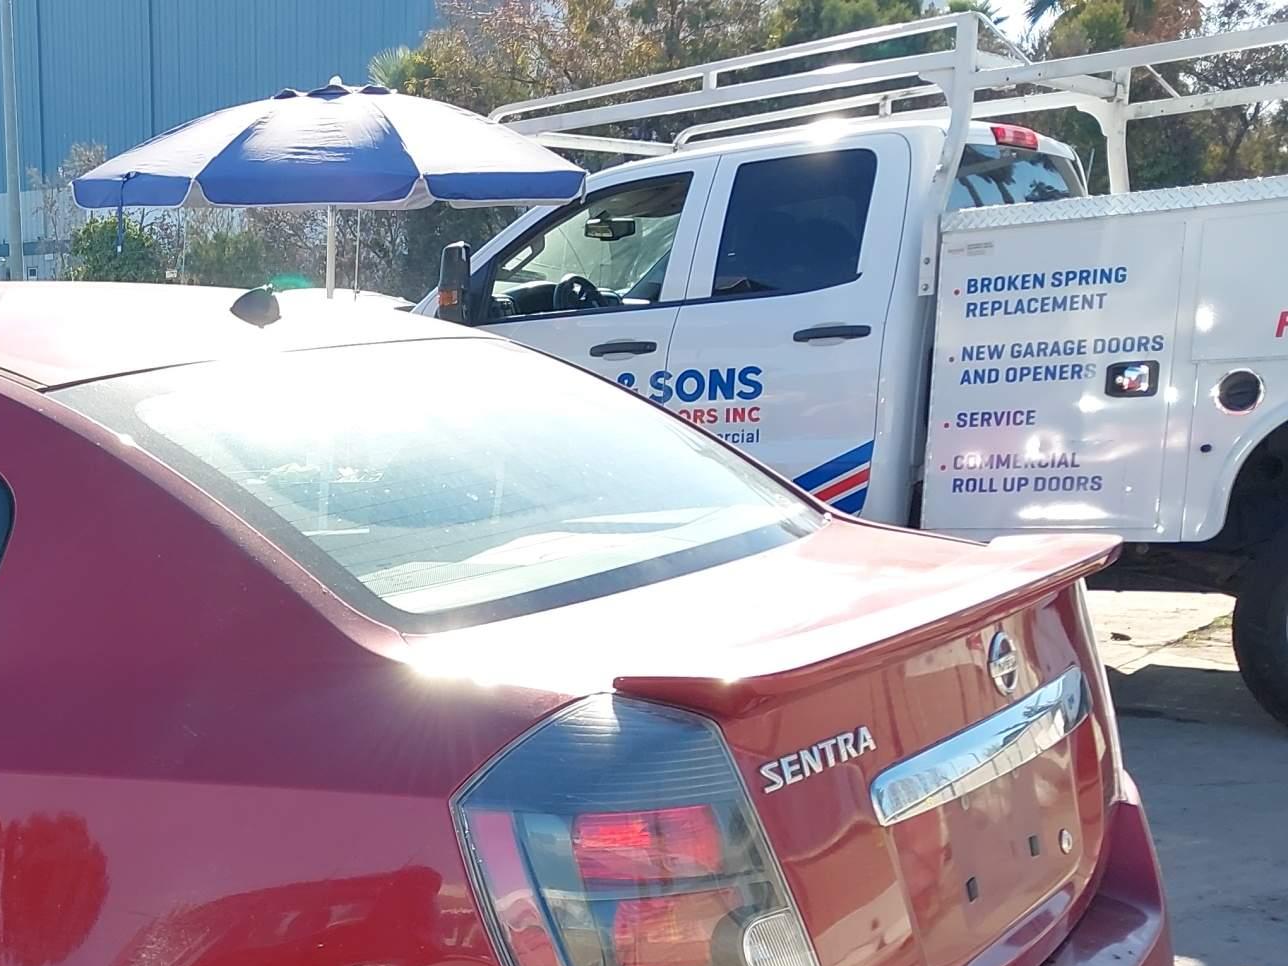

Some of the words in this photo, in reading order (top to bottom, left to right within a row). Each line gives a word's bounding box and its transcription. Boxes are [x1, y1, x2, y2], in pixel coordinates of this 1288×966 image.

[966, 273, 1045, 295] BROKEN
[1050, 266, 1128, 288] SPRING
[965, 292, 1107, 318] REPLACEMENT
[961, 344, 1005, 362] NEW
[1010, 339, 1087, 359] GARAGE
[1093, 335, 1164, 355] DOORS
[649, 366, 763, 405] SONS
[960, 367, 999, 385] AND
[1005, 362, 1097, 383] OPENERS
[725, 406, 761, 424] INC
[956, 410, 1037, 429] SERVICE
[952, 477, 998, 493] ROLL
[1003, 477, 1028, 493] UP
[1033, 475, 1103, 493] DOORS
[759, 724, 878, 794] SENTRA
